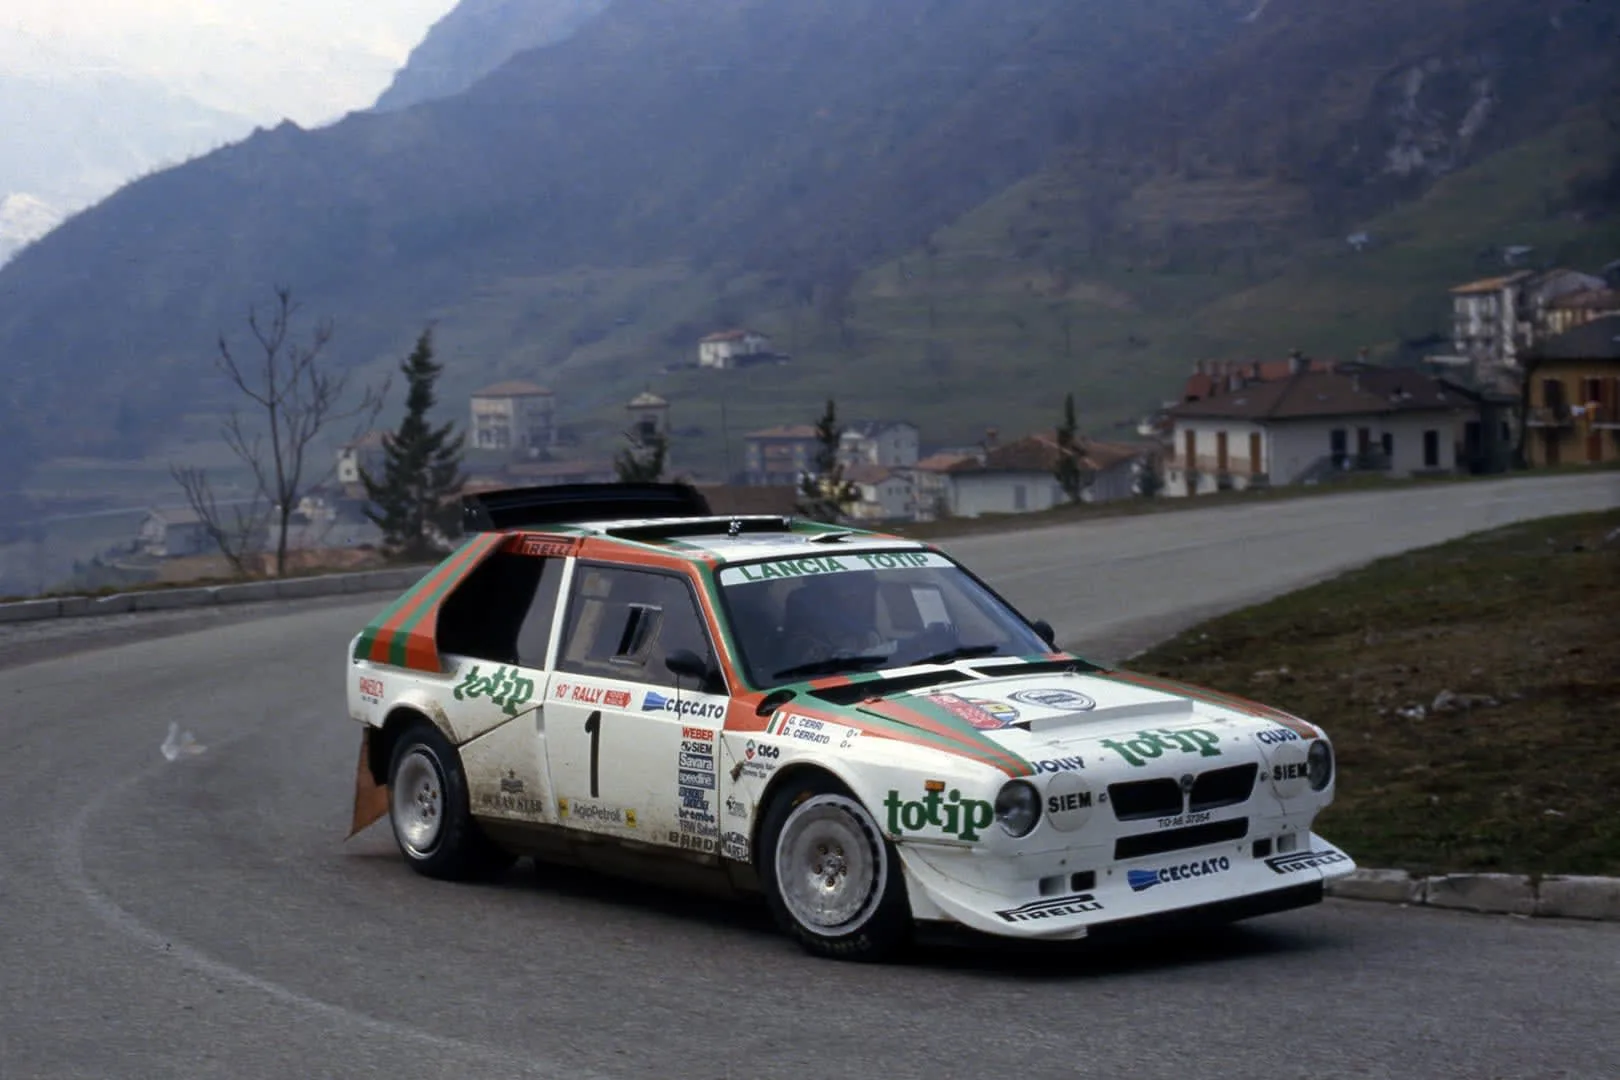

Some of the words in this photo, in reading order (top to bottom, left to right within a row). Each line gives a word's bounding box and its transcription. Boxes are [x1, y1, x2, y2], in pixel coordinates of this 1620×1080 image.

[739, 556, 848, 581] LANCIA
[858, 552, 928, 569] TOTIP
[453, 665, 534, 715] totip
[571, 685, 604, 705] RALLY
[665, 698, 724, 719] CECCATO
[682, 727, 714, 741] WEBER
[798, 718, 824, 729] CERRI
[783, 728, 790, 736] D.
[793, 730, 830, 744] CERRATO
[1256, 729, 1297, 744] CLUB
[584, 710, 601, 798] 1
[691, 741, 712, 754] SIEM
[1100, 729, 1222, 767] totip
[679, 753, 713, 770] Savara
[1033, 756, 1085, 773] JOLLY
[1273, 763, 1309, 781] SIEM
[1048, 791, 1092, 813] SIEM
[884, 788, 995, 842] totip
[1158, 856, 1230, 882] CECCATO
[1264, 850, 1349, 874] PIRELLI
[994, 894, 1104, 922] PIRELLI
